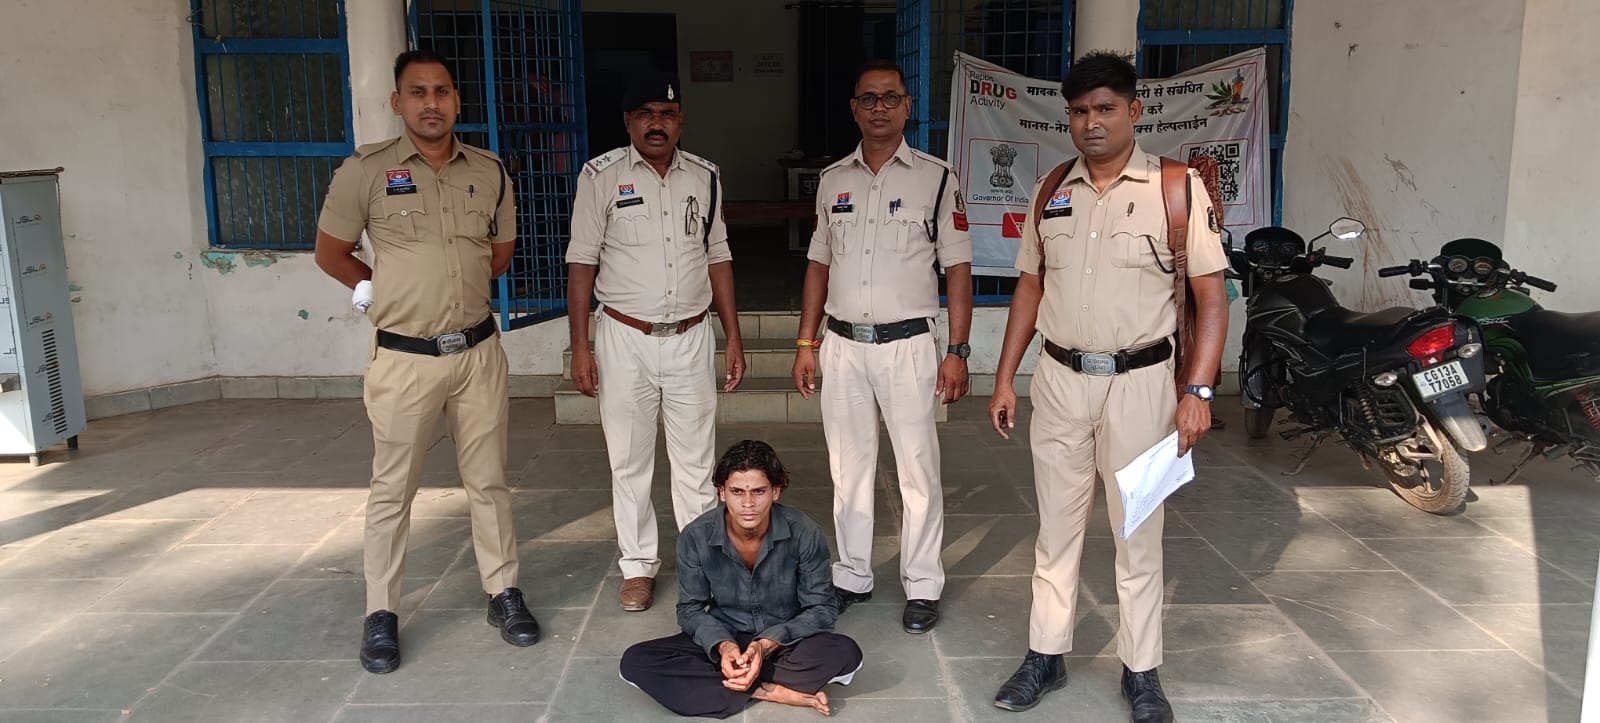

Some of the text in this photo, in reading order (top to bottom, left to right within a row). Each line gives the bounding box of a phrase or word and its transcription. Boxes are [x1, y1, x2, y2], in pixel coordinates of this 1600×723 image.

[970, 79, 1017, 99] DRUG
[1026, 86, 1058, 97] मादक
[1154, 84, 1164, 97] से
[970, 95, 1006, 110] Activity
[1005, 194, 1014, 202] Of
[1014, 195, 1029, 204] India
[1424, 364, 1458, 382] CG13A
[1429, 375, 1462, 393] T7058
